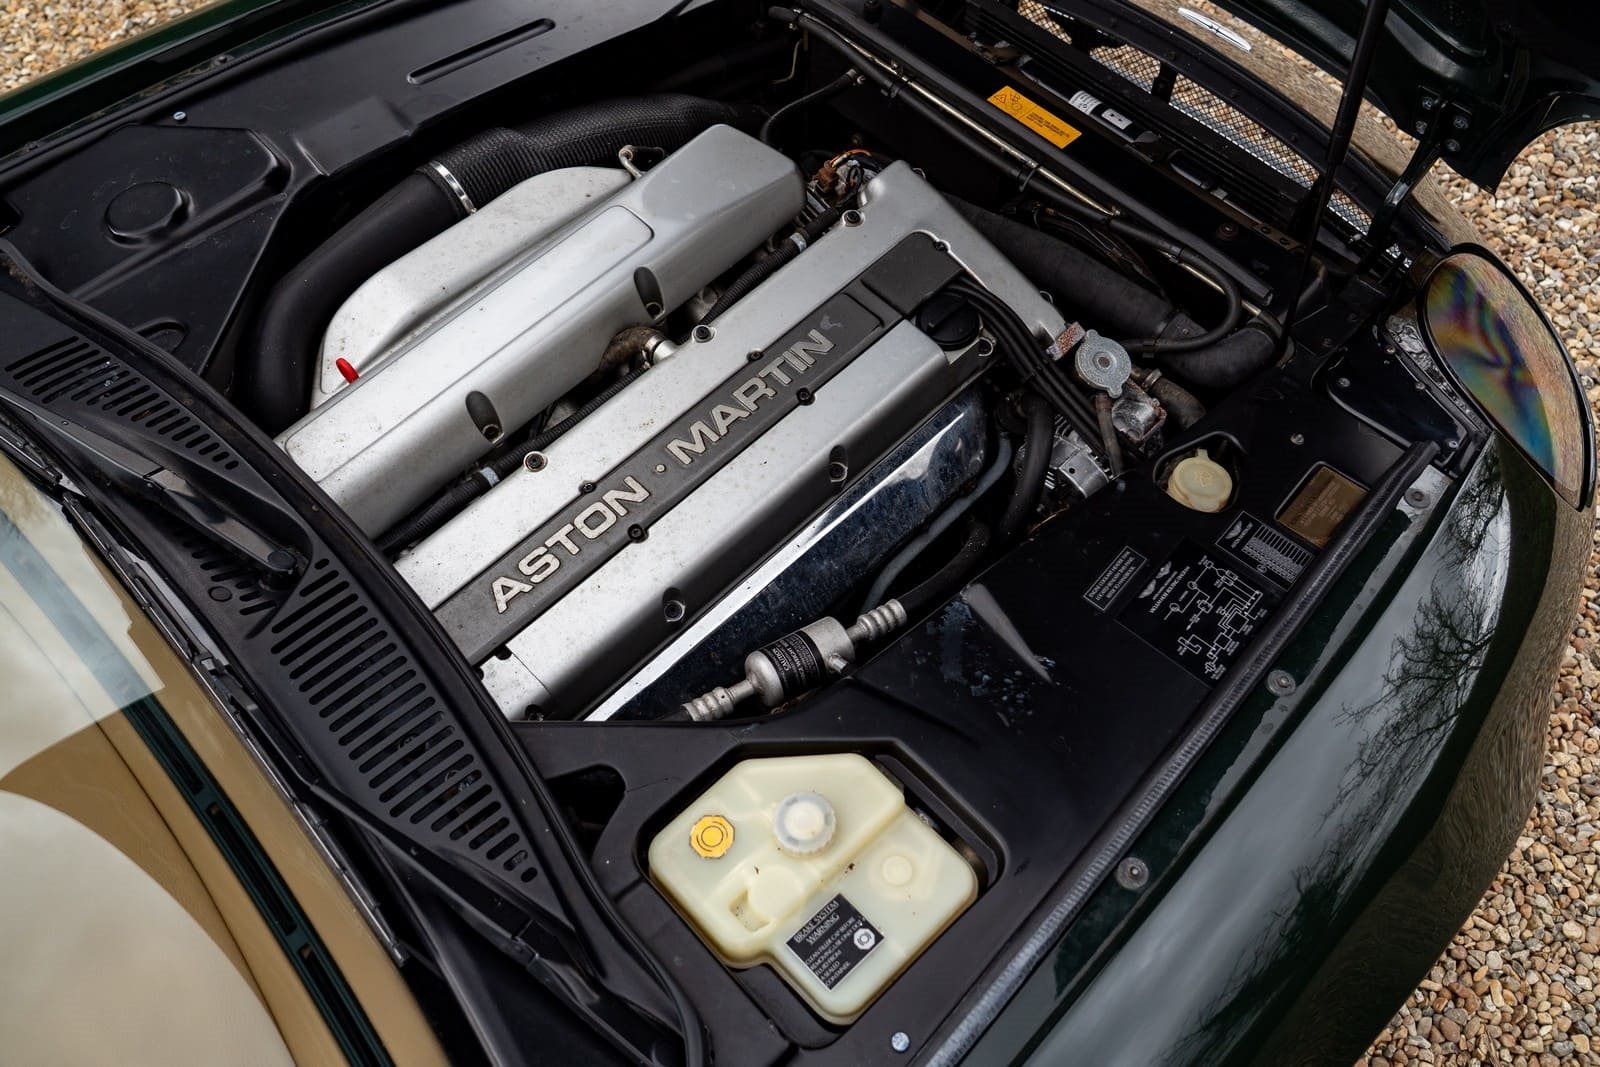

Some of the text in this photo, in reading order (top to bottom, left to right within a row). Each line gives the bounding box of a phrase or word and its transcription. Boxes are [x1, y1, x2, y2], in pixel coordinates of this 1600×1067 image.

[491, 328, 835, 614] ASTON MARTIN
[772, 647, 790, 671] CAUTION
[792, 899, 839, 943] BRAKE SYSTEM
[805, 911, 840, 945] WARNING
